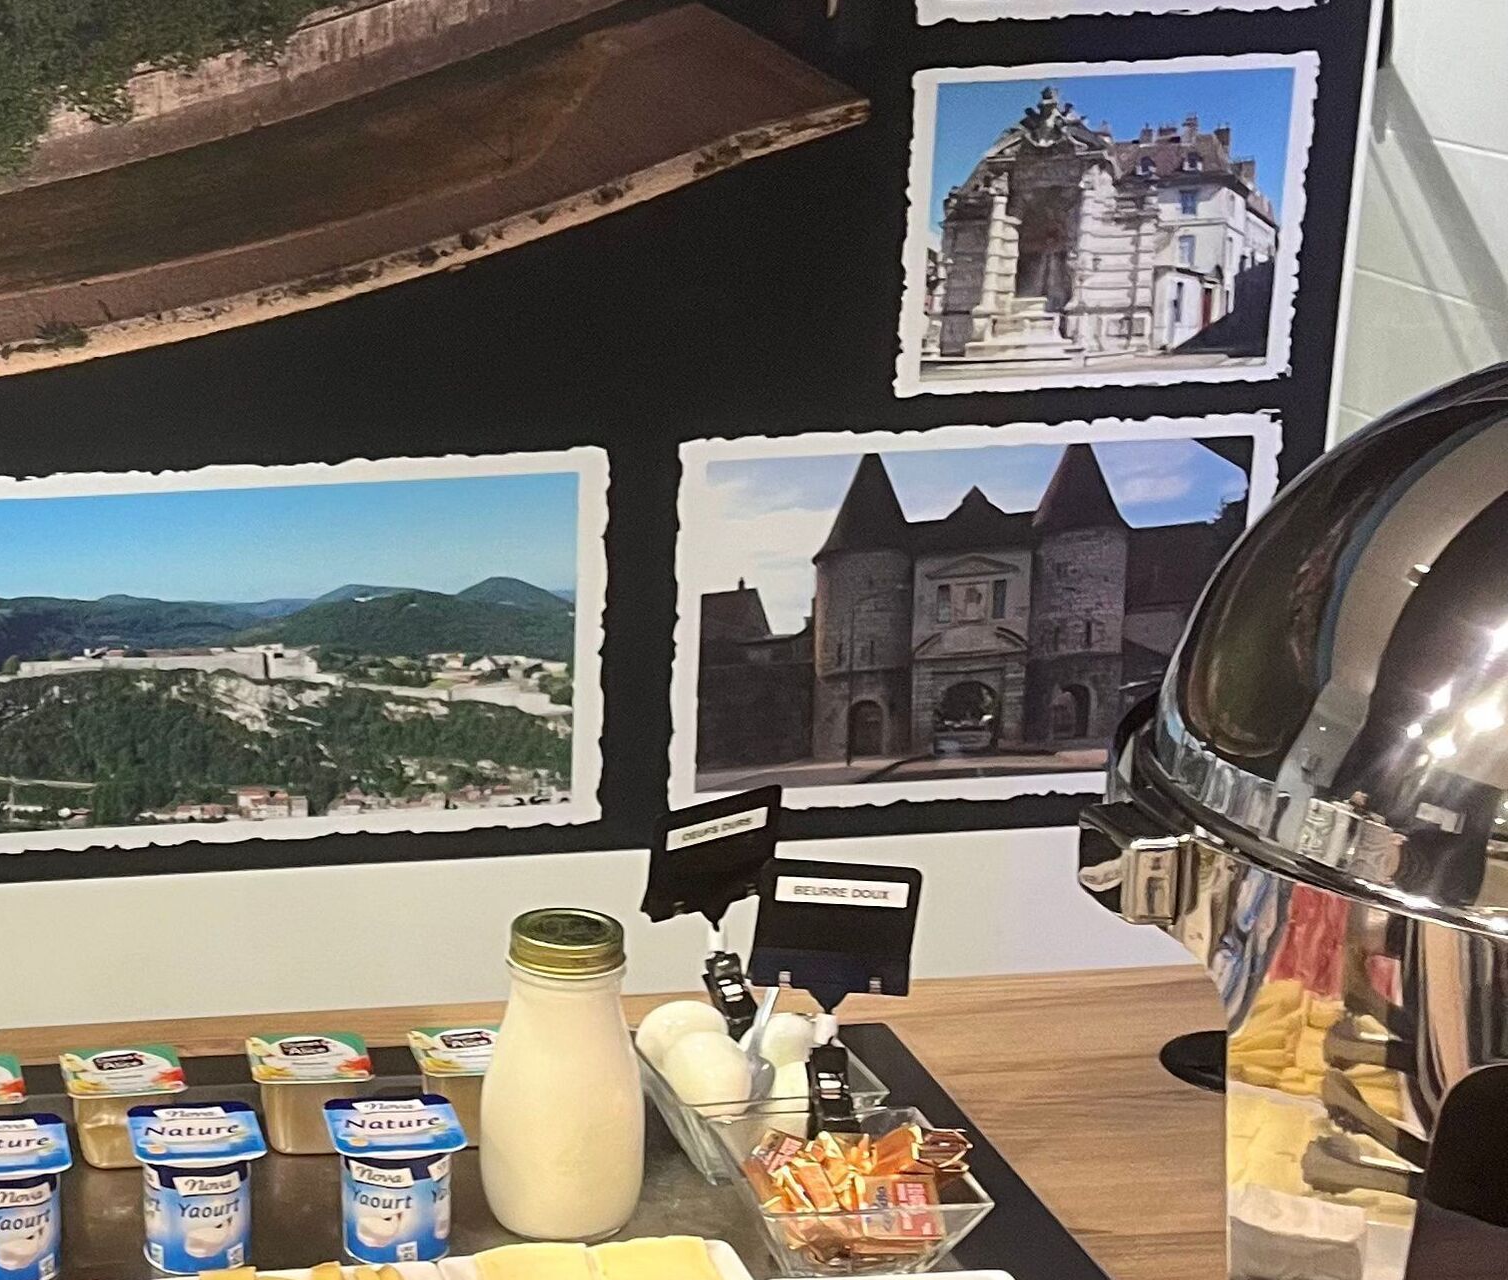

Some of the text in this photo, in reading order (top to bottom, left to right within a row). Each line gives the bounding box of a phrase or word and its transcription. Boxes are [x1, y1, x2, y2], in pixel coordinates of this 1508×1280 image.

[793, 885, 889, 900] BEURRE DOUX
[144, 1124, 240, 1137] Nature
[345, 1116, 440, 1130] Nature
[352, 1188, 412, 1209] Yaourt
[178, 1198, 240, 1218] Yaourt
